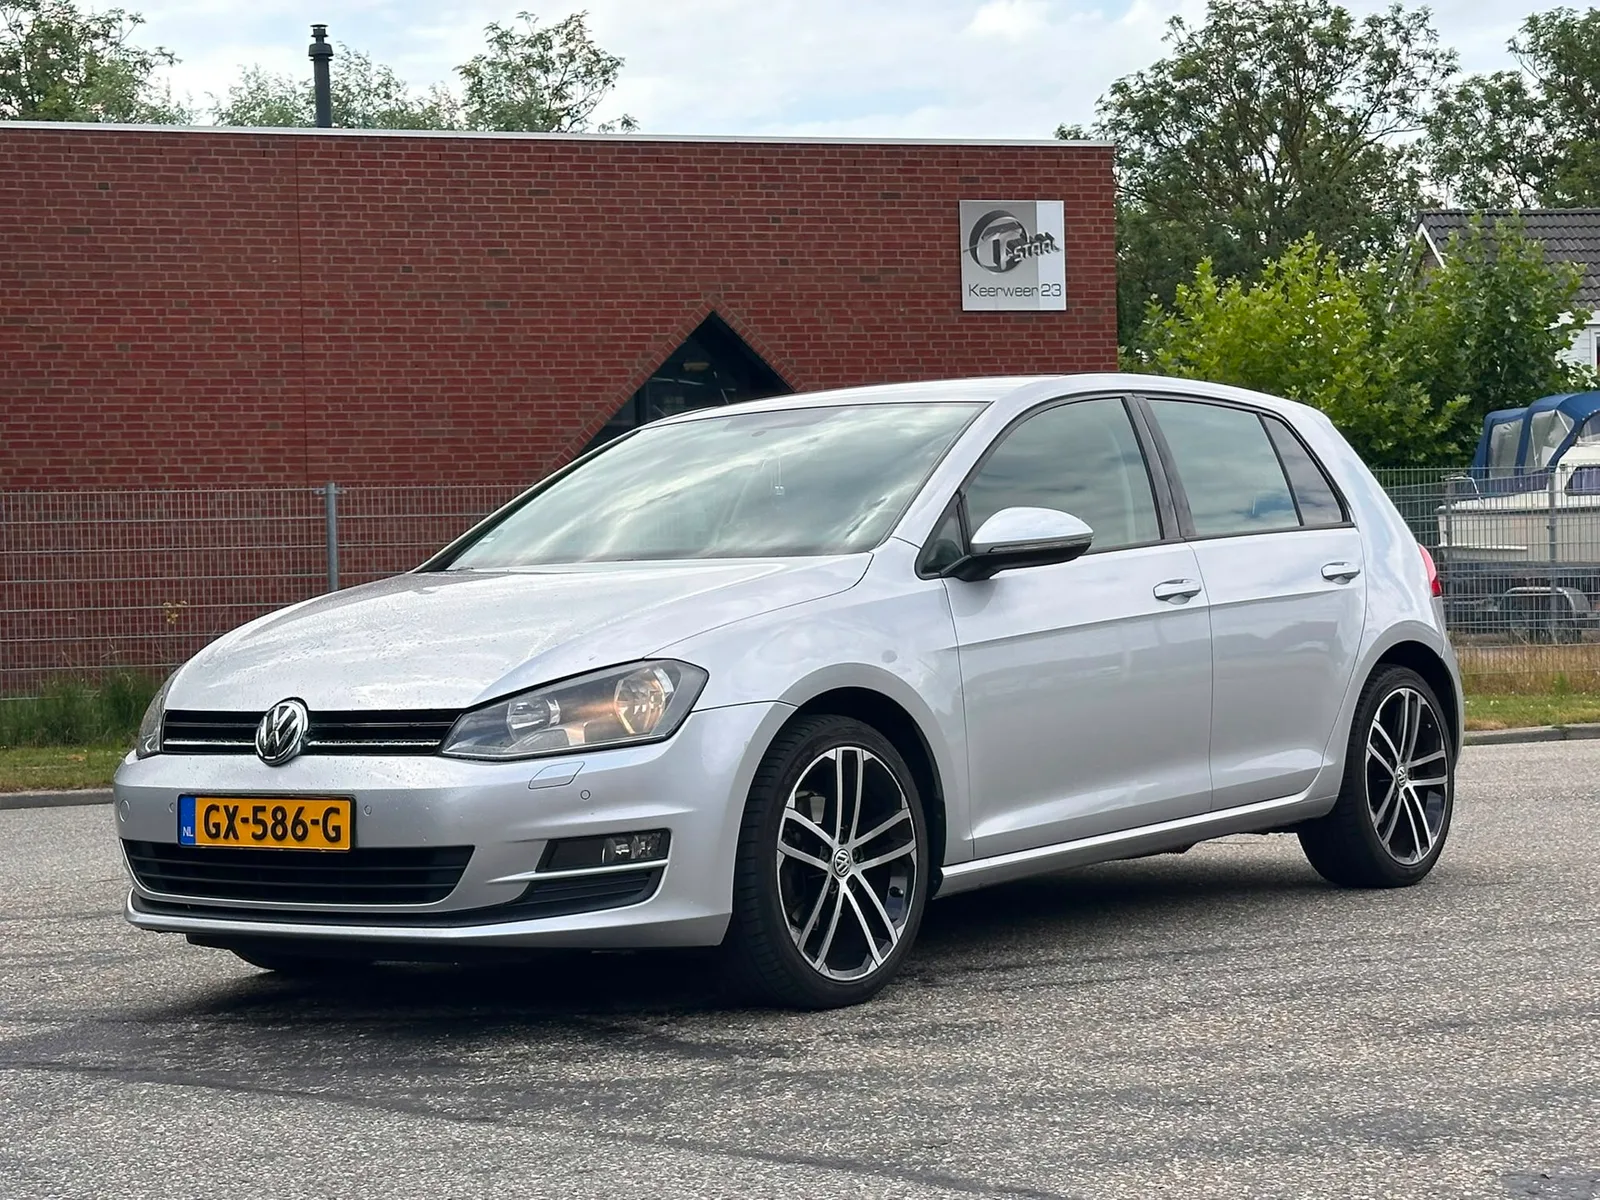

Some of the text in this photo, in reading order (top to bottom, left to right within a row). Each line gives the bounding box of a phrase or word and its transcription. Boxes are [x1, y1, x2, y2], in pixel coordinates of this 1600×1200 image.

[968, 283, 1061, 297] Keerweer 23
[203, 804, 342, 843] GX-586-G
[182, 826, 194, 838] NL
